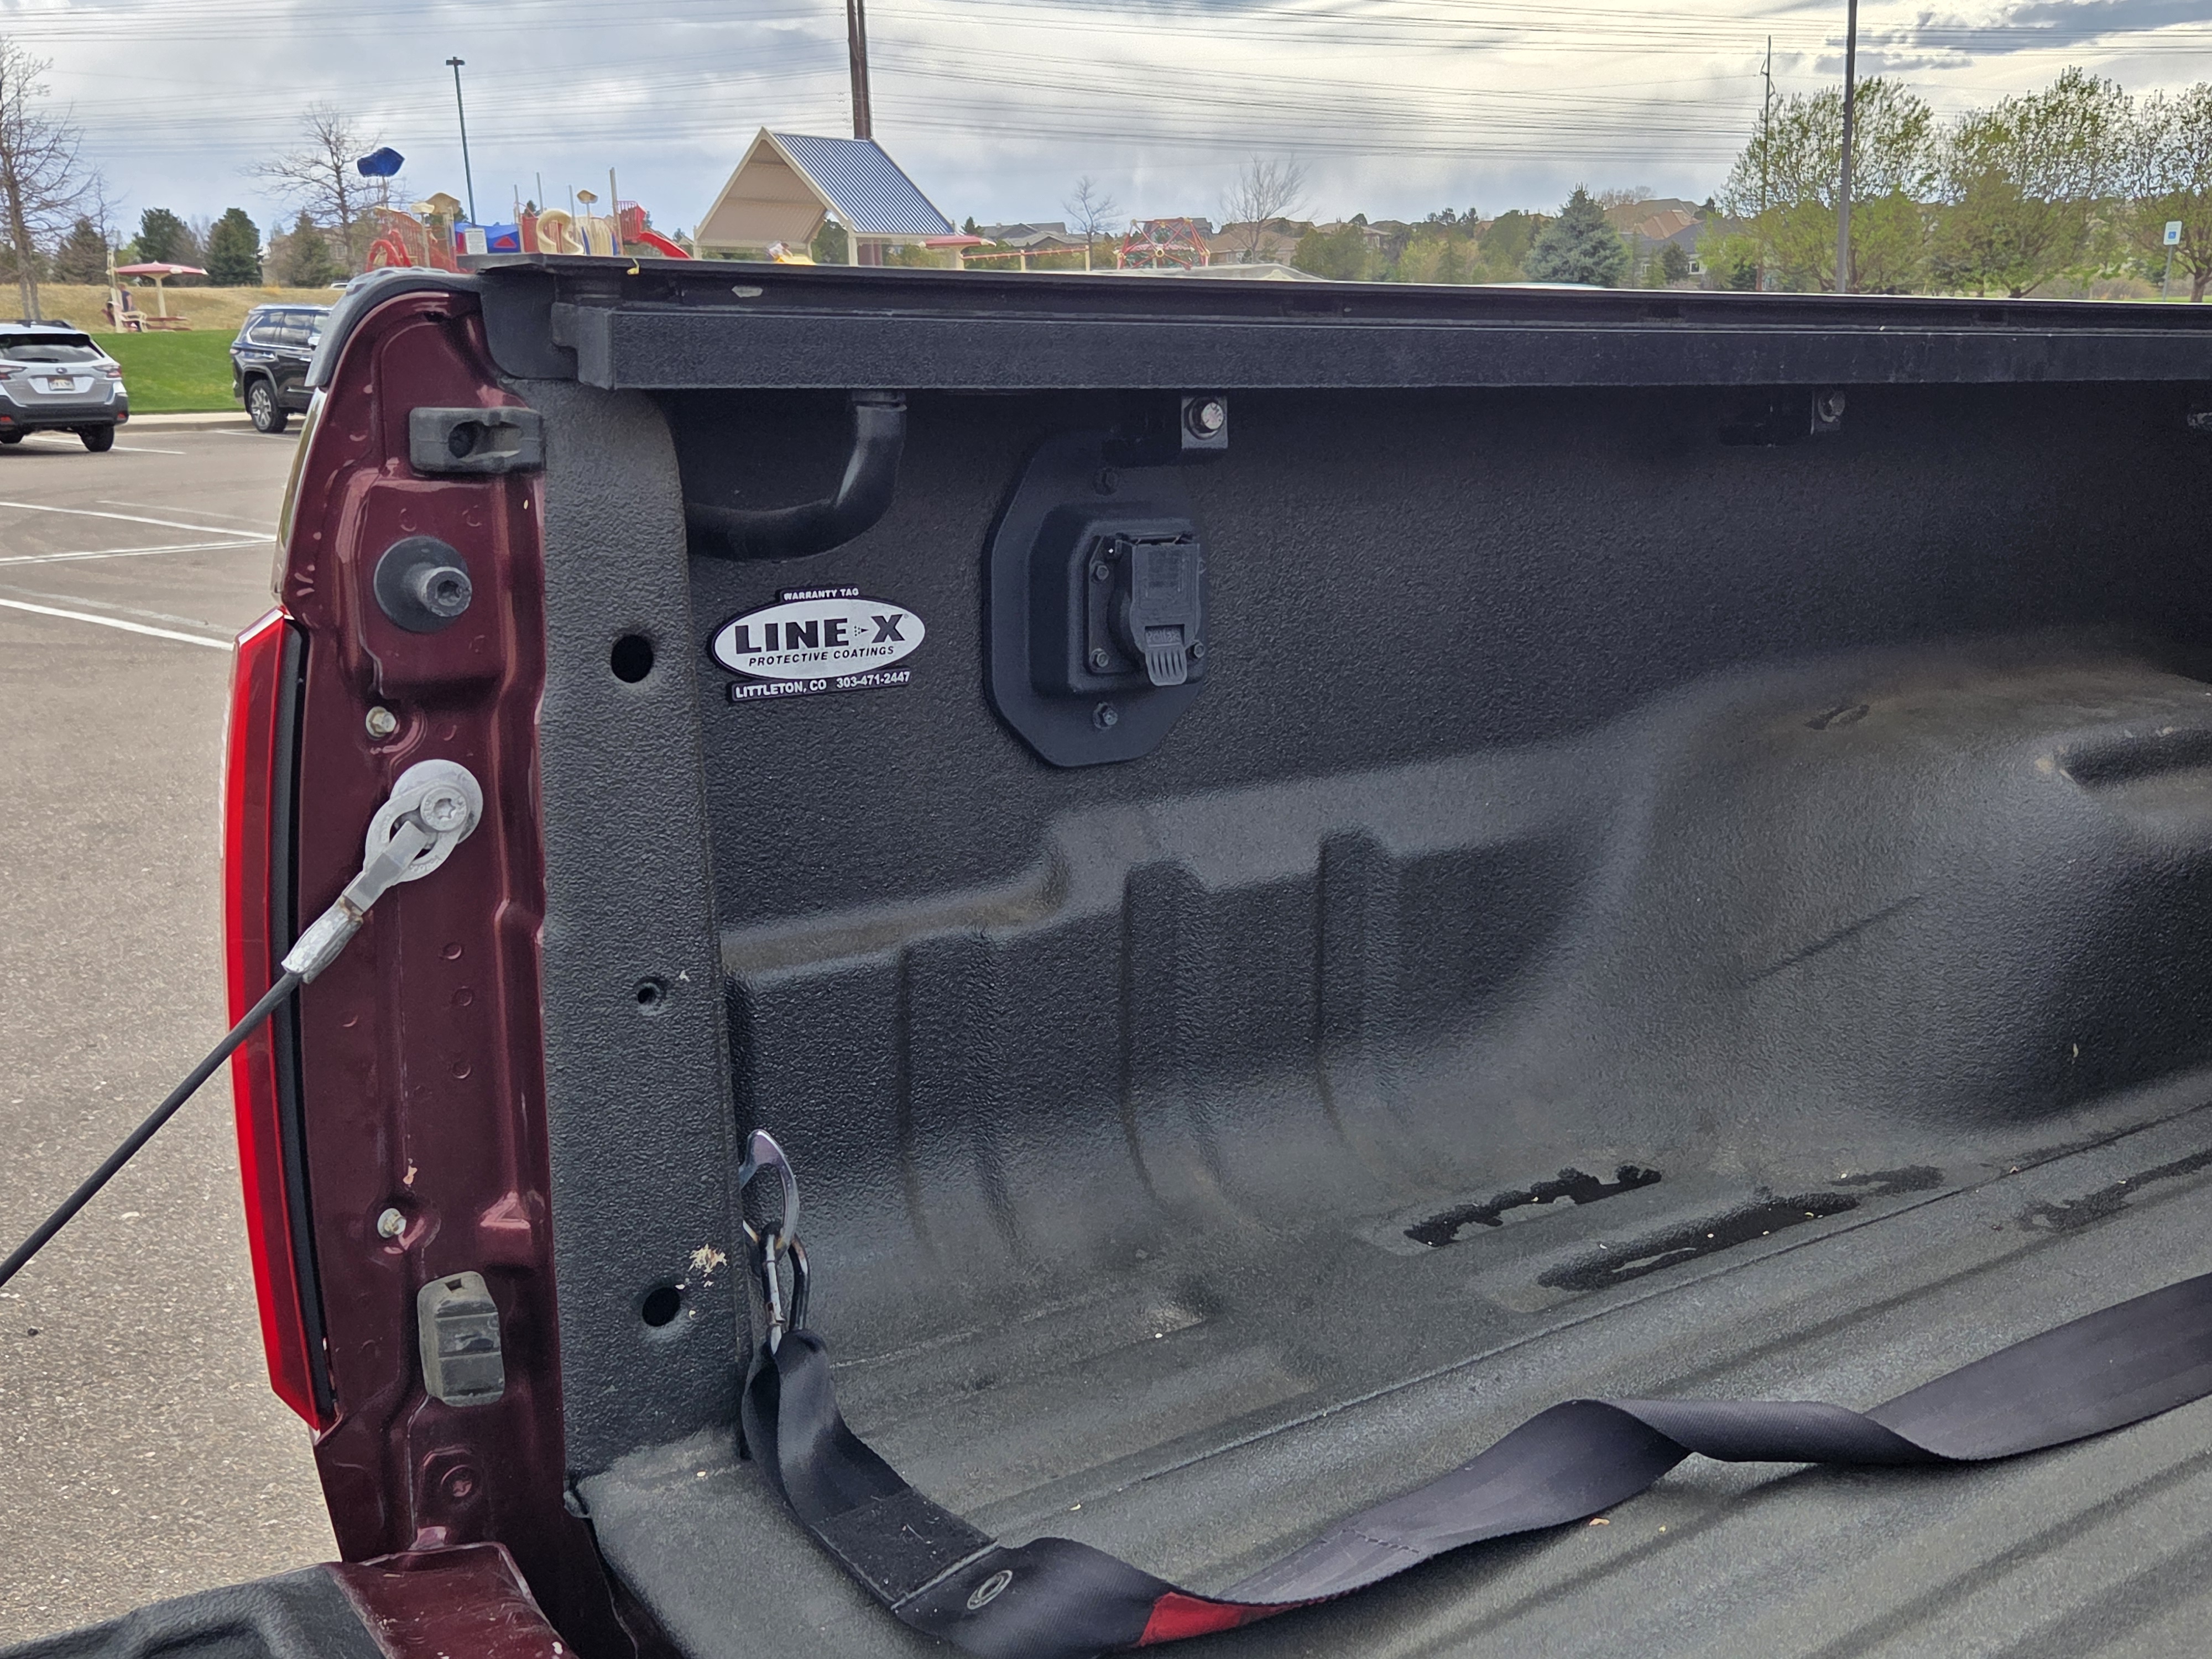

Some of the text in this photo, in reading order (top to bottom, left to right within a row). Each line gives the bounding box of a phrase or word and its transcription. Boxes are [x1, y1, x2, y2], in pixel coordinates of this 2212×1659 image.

[784, 588, 859, 601] WARRANTY TAG
[749, 646, 894, 666] PROTECTIVE COATINGS
[735, 671, 910, 698] LITTLETON, CO 303-471-2447
